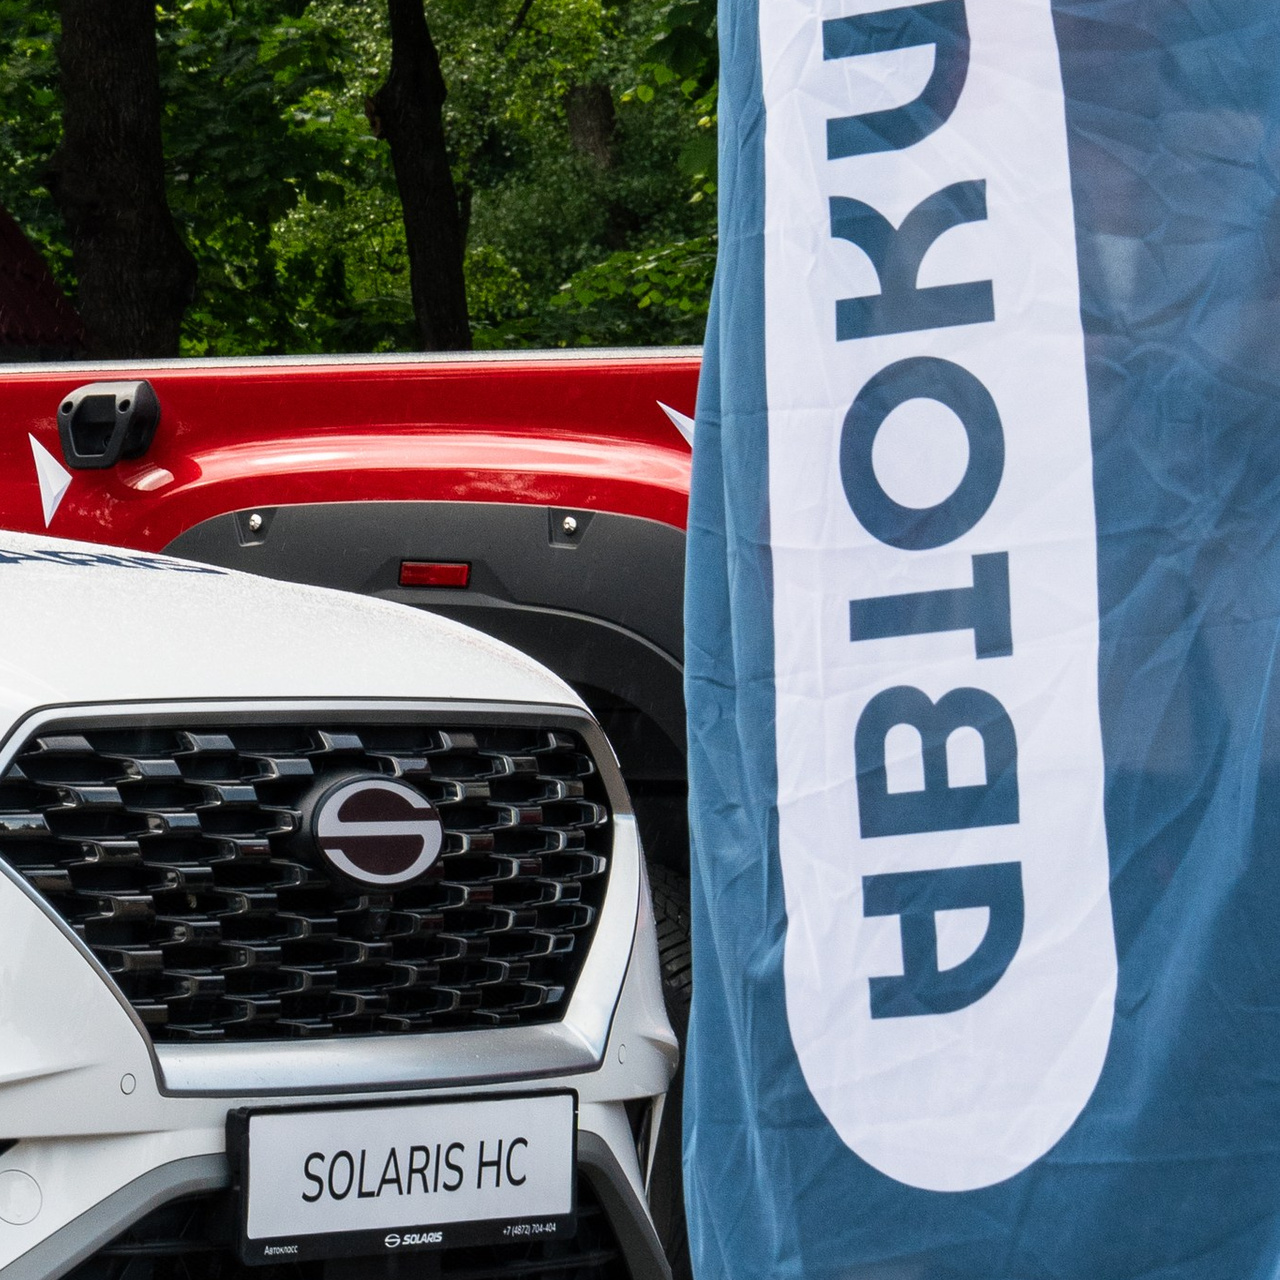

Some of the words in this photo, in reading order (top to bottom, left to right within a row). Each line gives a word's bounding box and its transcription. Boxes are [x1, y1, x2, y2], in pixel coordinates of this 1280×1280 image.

[301, 1142, 465, 1203] SOLARIS
[477, 1137, 528, 1189] HC
[502, 1225, 512, 1236] +7
[531, 1222, 557, 1234] 704-404
[401, 1231, 443, 1246] SOLARIS
[263, 1245, 299, 1256] Автокласс
